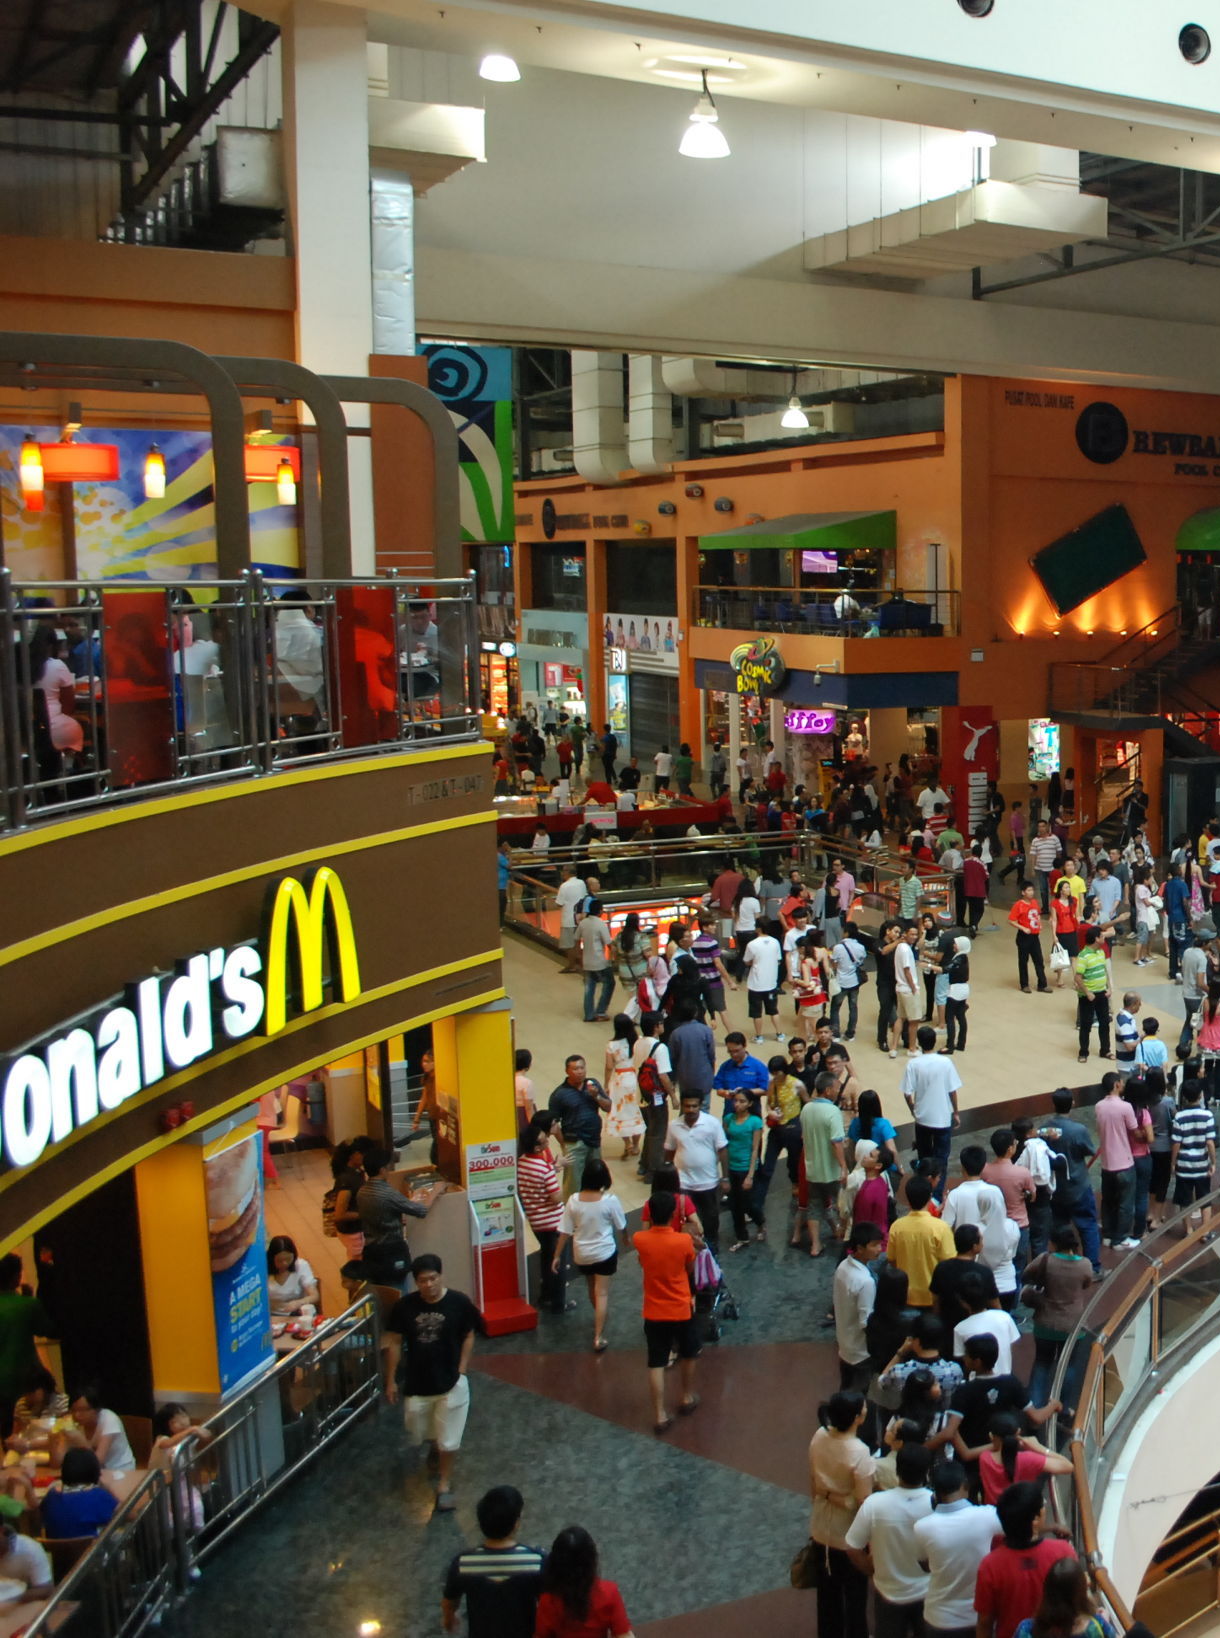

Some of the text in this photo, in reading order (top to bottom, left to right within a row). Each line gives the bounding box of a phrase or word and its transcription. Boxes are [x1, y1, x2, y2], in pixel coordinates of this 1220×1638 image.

[737, 675, 760, 695] BOWL
[741, 659, 773, 685] COSMIC
[0, 946, 265, 1167] onald's
[229, 1286, 262, 1324] START
